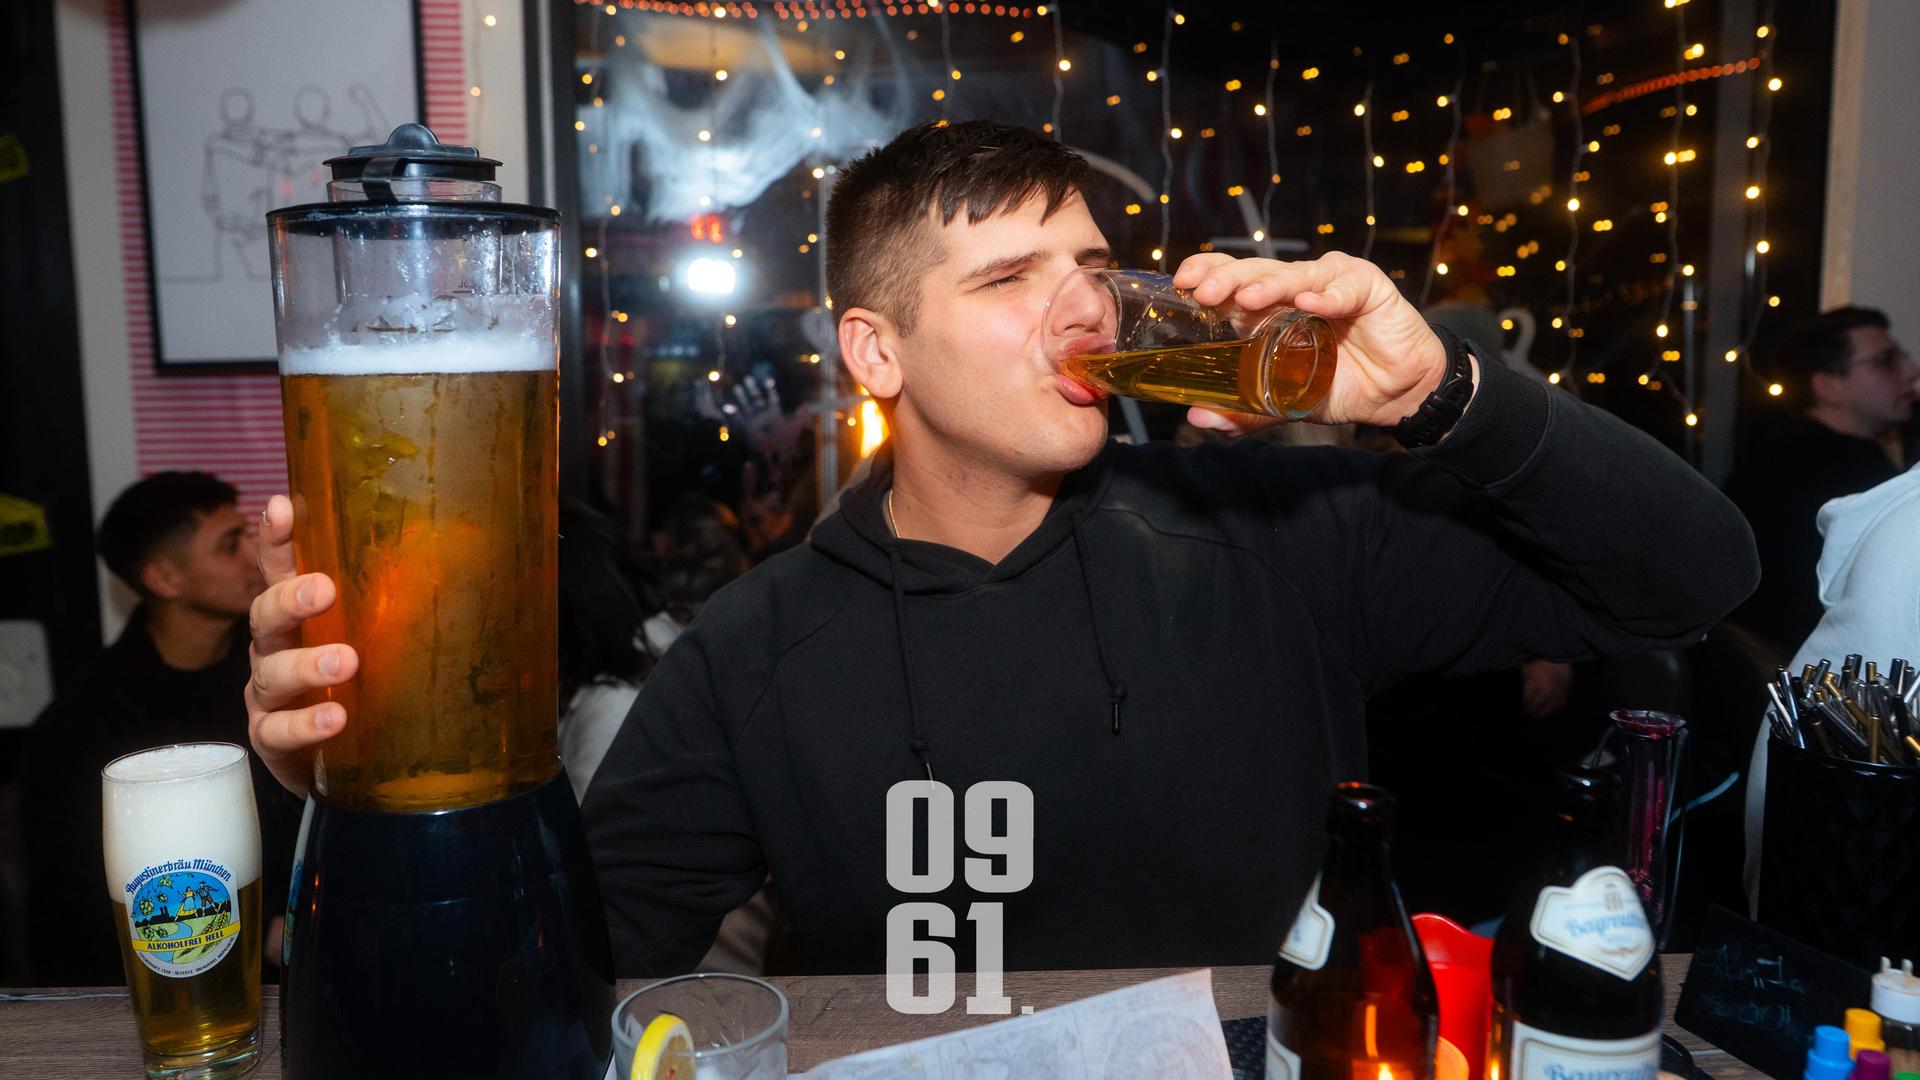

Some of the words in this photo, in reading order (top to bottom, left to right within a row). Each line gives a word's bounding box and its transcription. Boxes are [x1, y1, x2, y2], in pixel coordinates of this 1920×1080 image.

[125, 859, 192, 894] Augustinerbräu
[193, 859, 232, 881] München
[147, 936, 201, 950] ALKOHOLFREI
[205, 930, 224, 942] HELL
